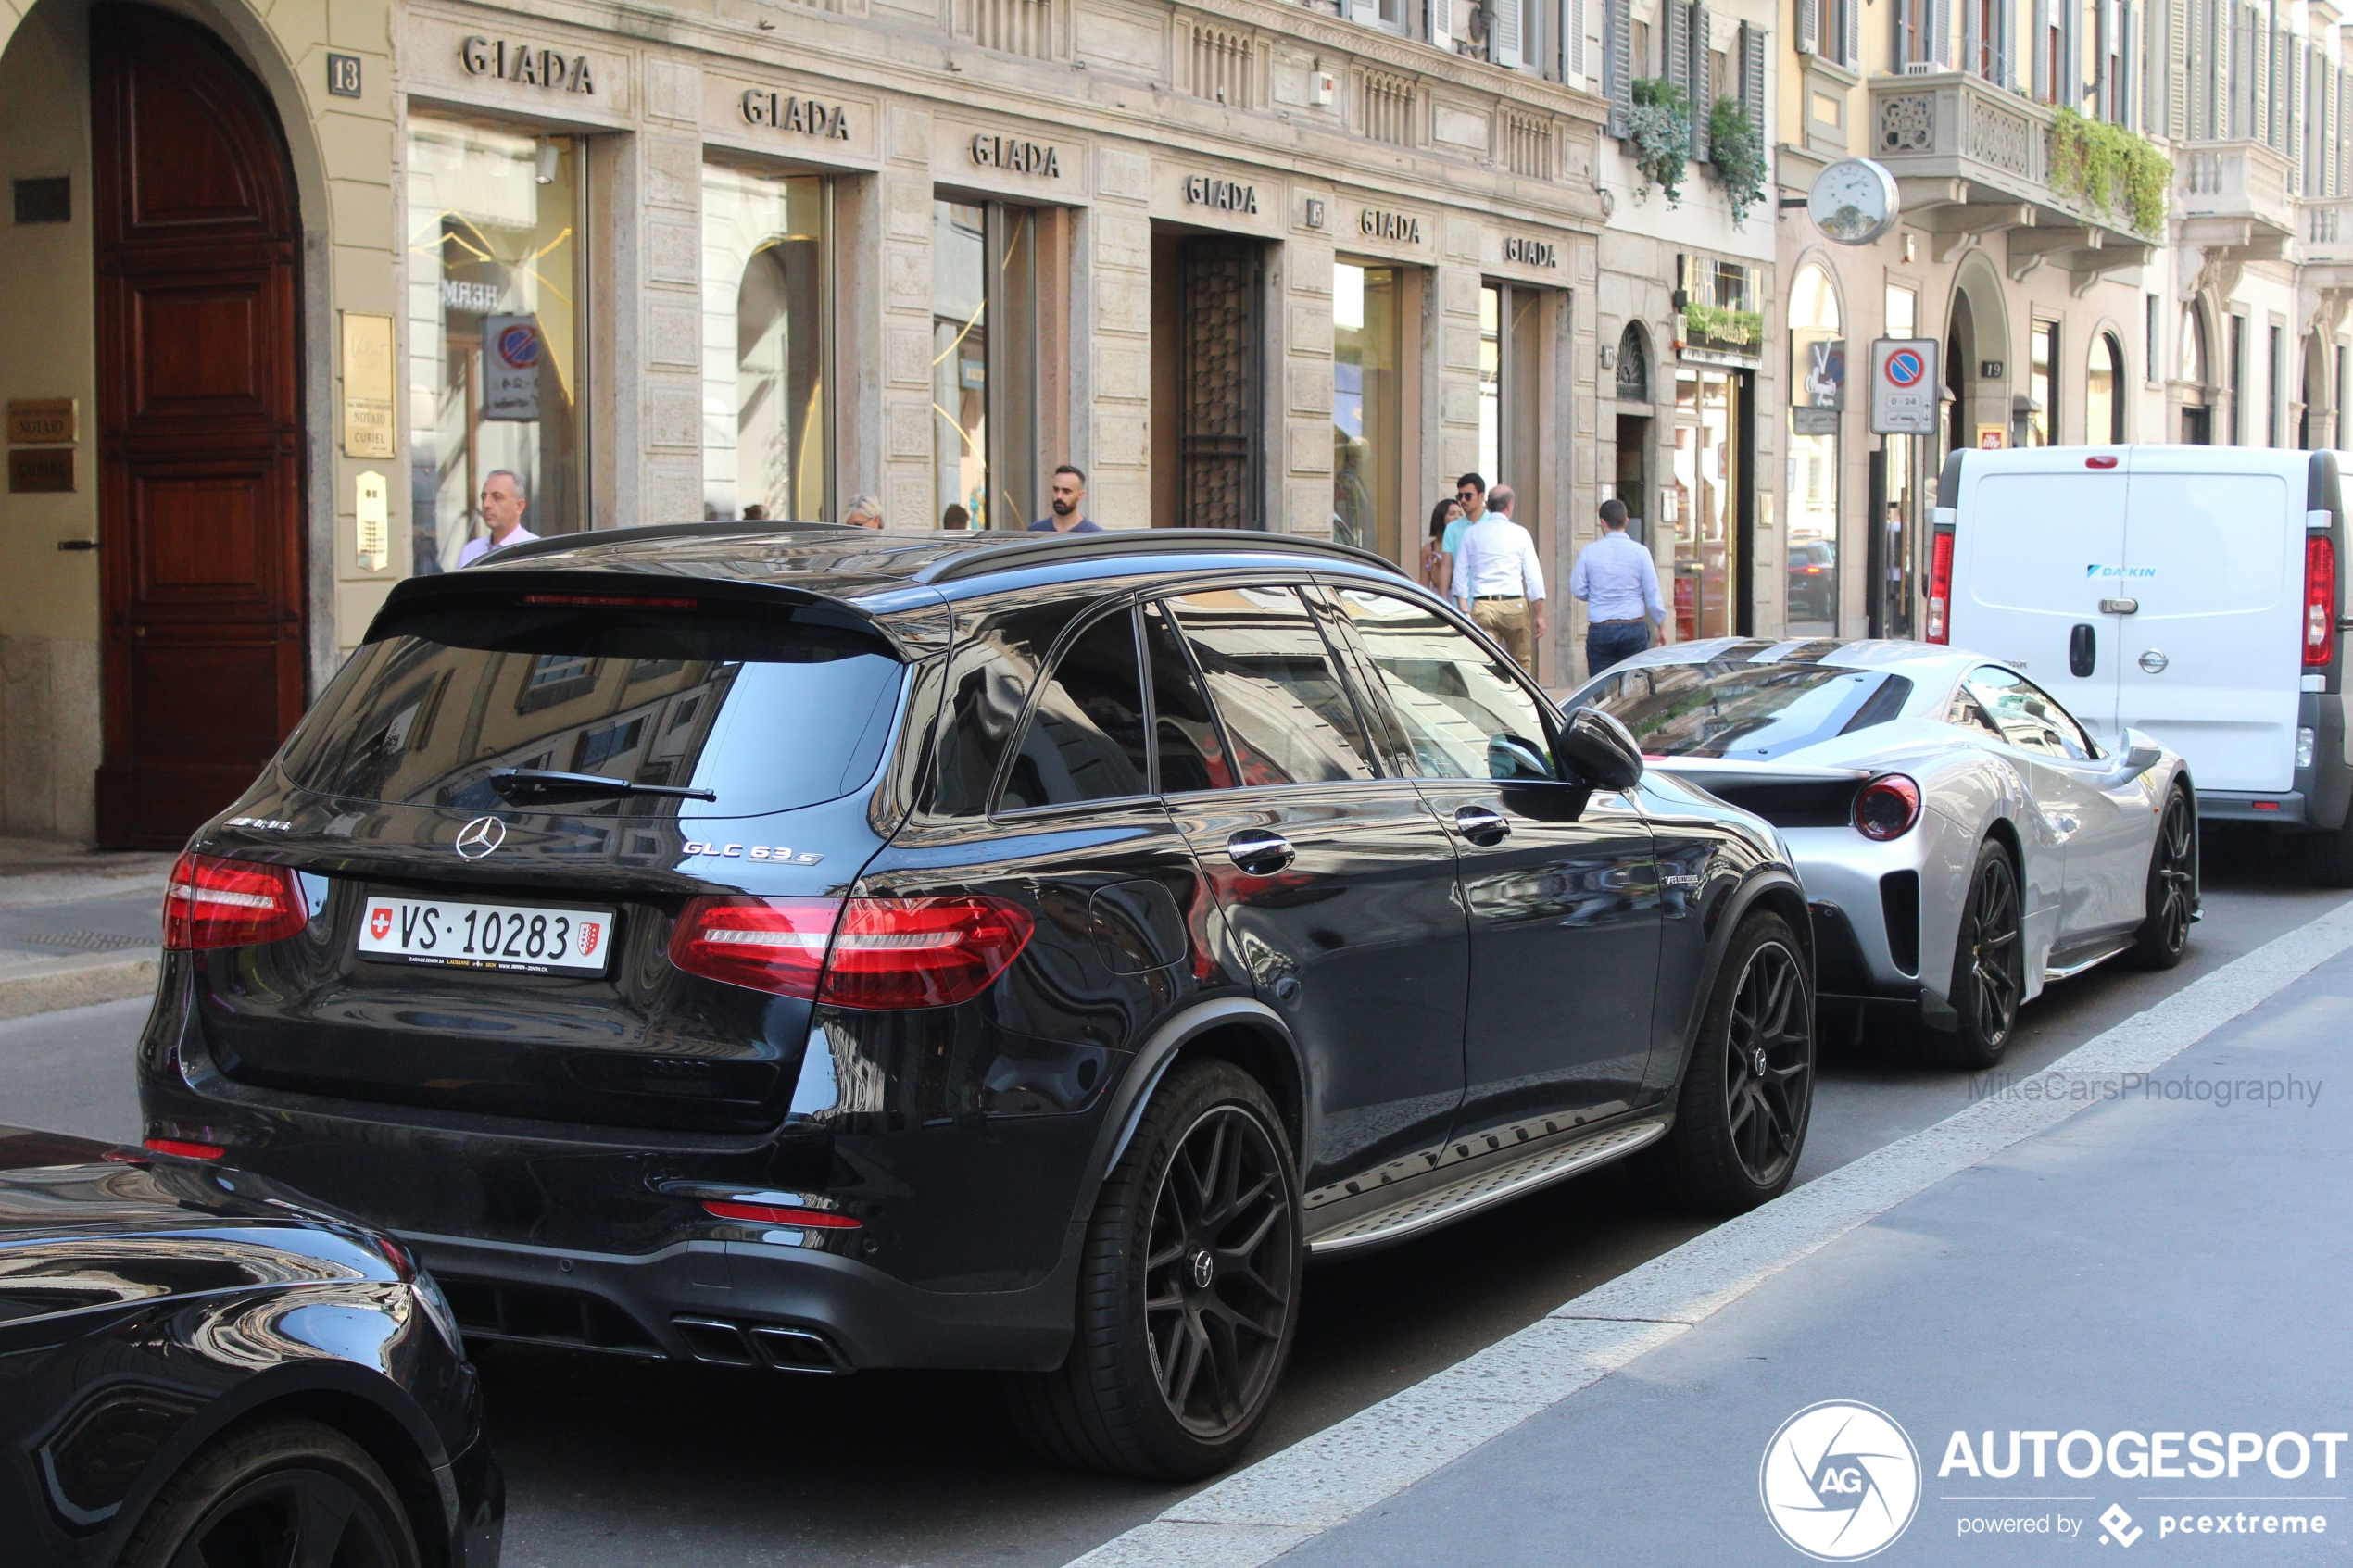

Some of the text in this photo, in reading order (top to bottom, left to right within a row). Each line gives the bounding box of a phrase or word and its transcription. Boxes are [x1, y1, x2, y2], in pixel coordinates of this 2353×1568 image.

[333, 58, 359, 92] 13
[461, 35, 596, 95] GIADA
[741, 89, 849, 141] GIADA
[971, 133, 1060, 178] GIADA
[1186, 174, 1259, 215] GIADA
[1311, 203, 1323, 224] 15
[1361, 208, 1421, 244] GIADA
[1505, 237, 1557, 269] GIADA
[1987, 363, 2002, 377] 19
[19, 420, 63, 434] NOTAIO
[353, 411, 386, 425] NOTAIO
[354, 432, 385, 445] CURIEL
[683, 841, 743, 858] GLC
[750, 846, 792, 859] 63
